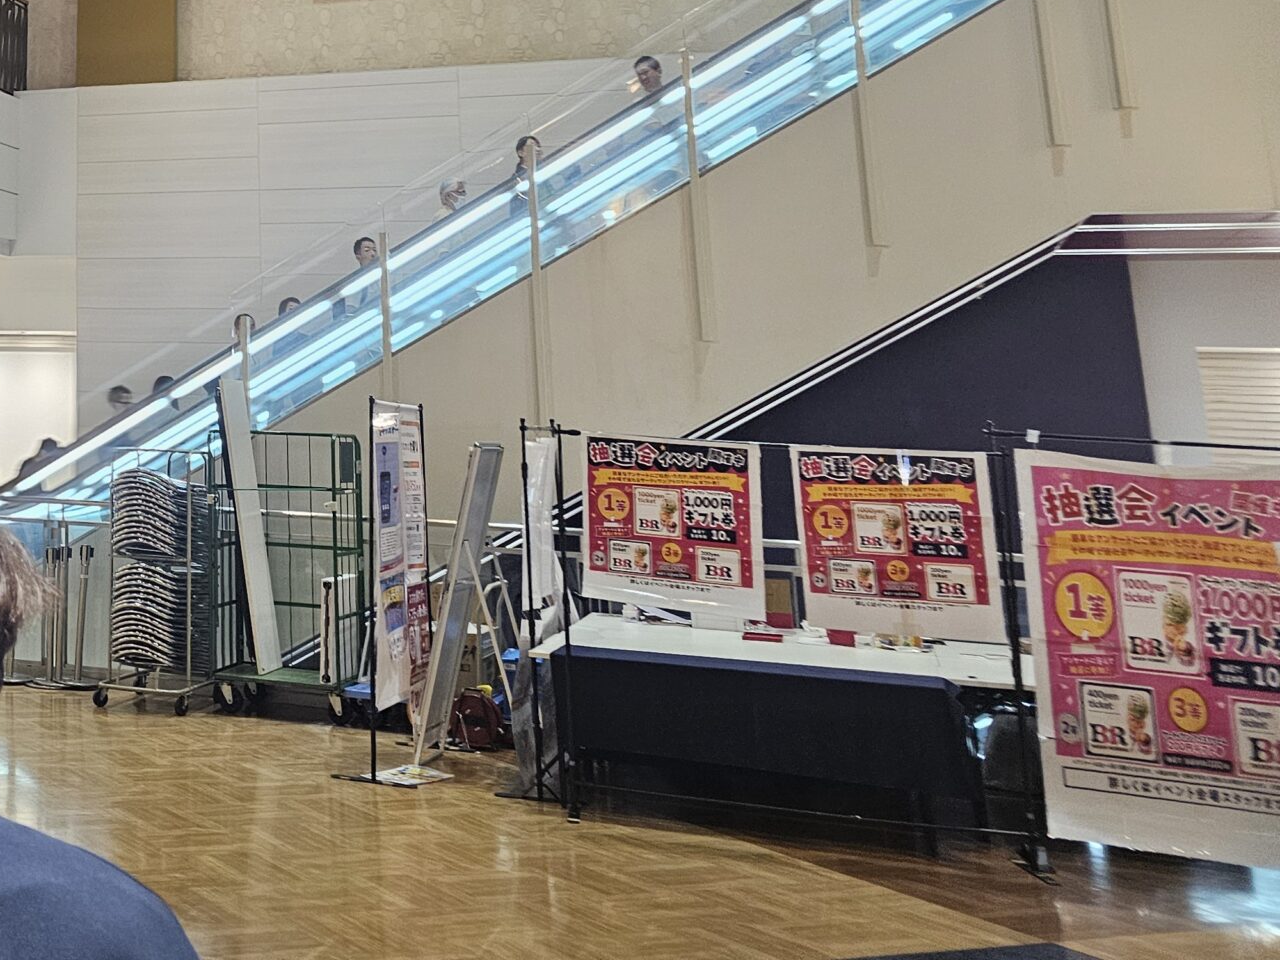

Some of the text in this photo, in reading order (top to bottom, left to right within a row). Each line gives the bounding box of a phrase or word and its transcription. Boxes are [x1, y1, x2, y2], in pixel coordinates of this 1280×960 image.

[684, 494, 732, 511] 1,000円
[908, 509, 962, 525] 1,000円
[1122, 577, 1168, 593] 1000yen
[1123, 591, 1157, 605] ticket
